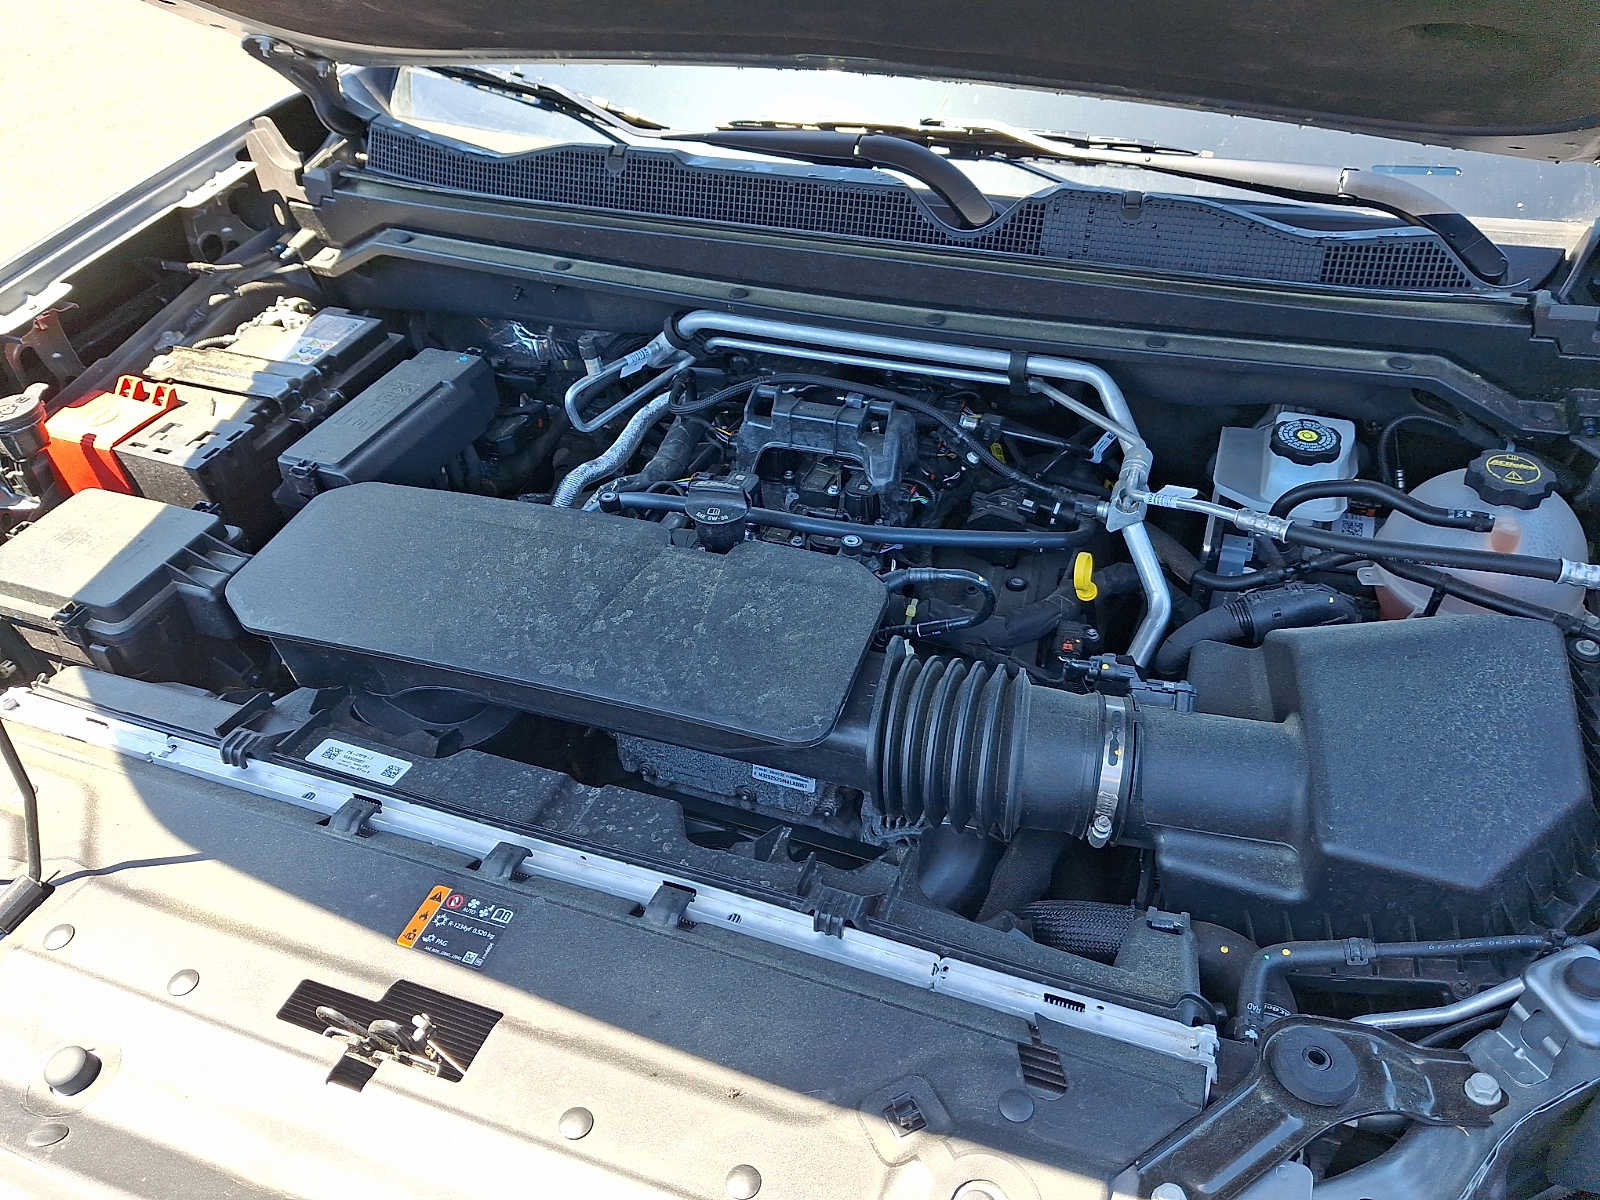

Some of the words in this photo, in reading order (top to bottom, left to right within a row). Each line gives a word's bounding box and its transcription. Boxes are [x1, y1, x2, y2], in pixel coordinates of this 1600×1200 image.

[462, 907, 477, 915] AUTO
[435, 937, 448, 946] PAG
[1247, 1002, 1261, 1014] RAD
